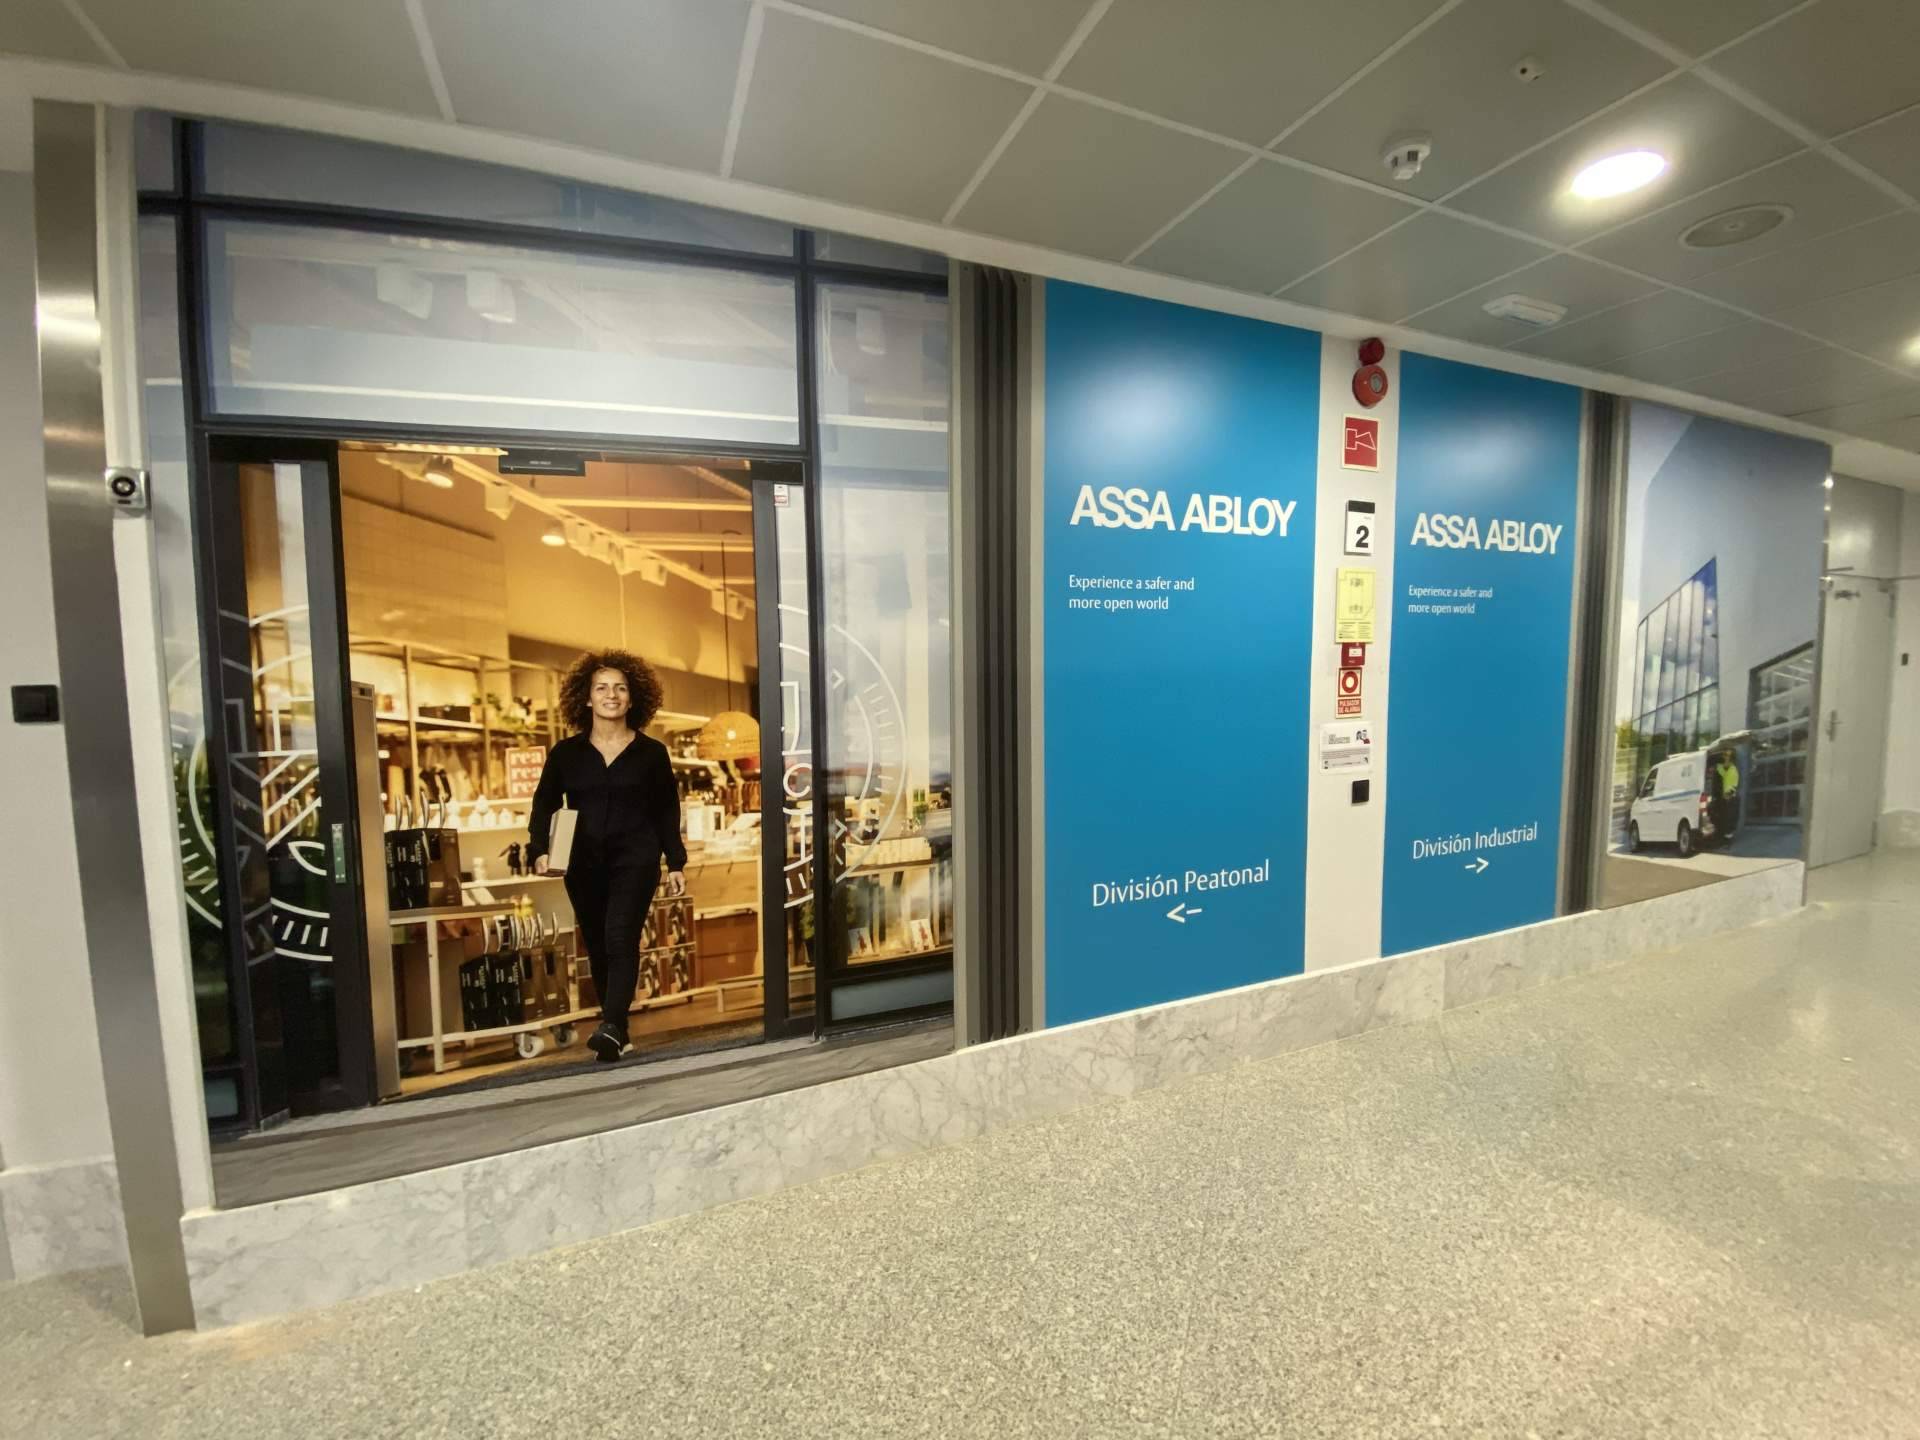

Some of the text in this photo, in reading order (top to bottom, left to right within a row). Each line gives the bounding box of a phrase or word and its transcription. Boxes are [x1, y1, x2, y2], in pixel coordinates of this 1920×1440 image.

[1069, 484, 1297, 537] ASSA ABLOY
[1355, 525, 1369, 548] 2
[1410, 512, 1563, 555] ASSA ABLOY
[1069, 574, 1195, 592] Experience a safer and
[1408, 584, 1451, 599] Experience
[1458, 586, 1477, 598] safer
[1478, 587, 1493, 599] and
[1069, 596, 1169, 612] more open world
[1408, 602, 1476, 616] more open world
[1412, 821, 1538, 860] División Industrial
[1092, 858, 1270, 907] División Peatonal
